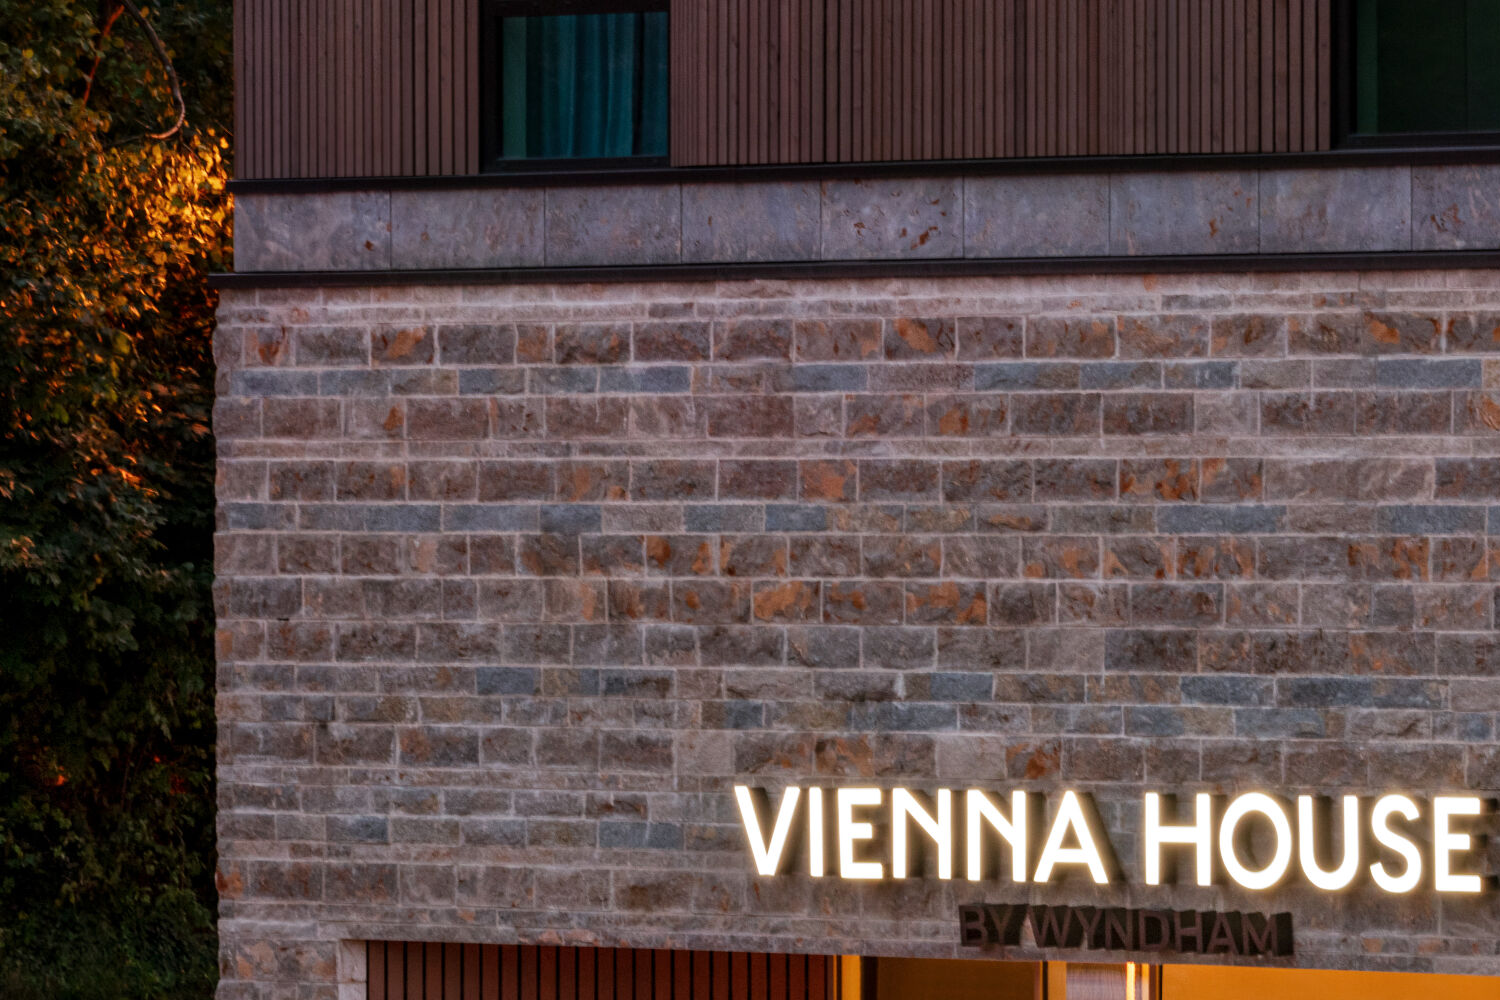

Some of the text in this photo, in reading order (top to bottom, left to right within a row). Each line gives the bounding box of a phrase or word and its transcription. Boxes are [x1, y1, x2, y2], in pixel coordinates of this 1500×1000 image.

[734, 785, 1482, 893] VIENNA HOUSE
[959, 904, 1281, 955] BY WYNDHAM
